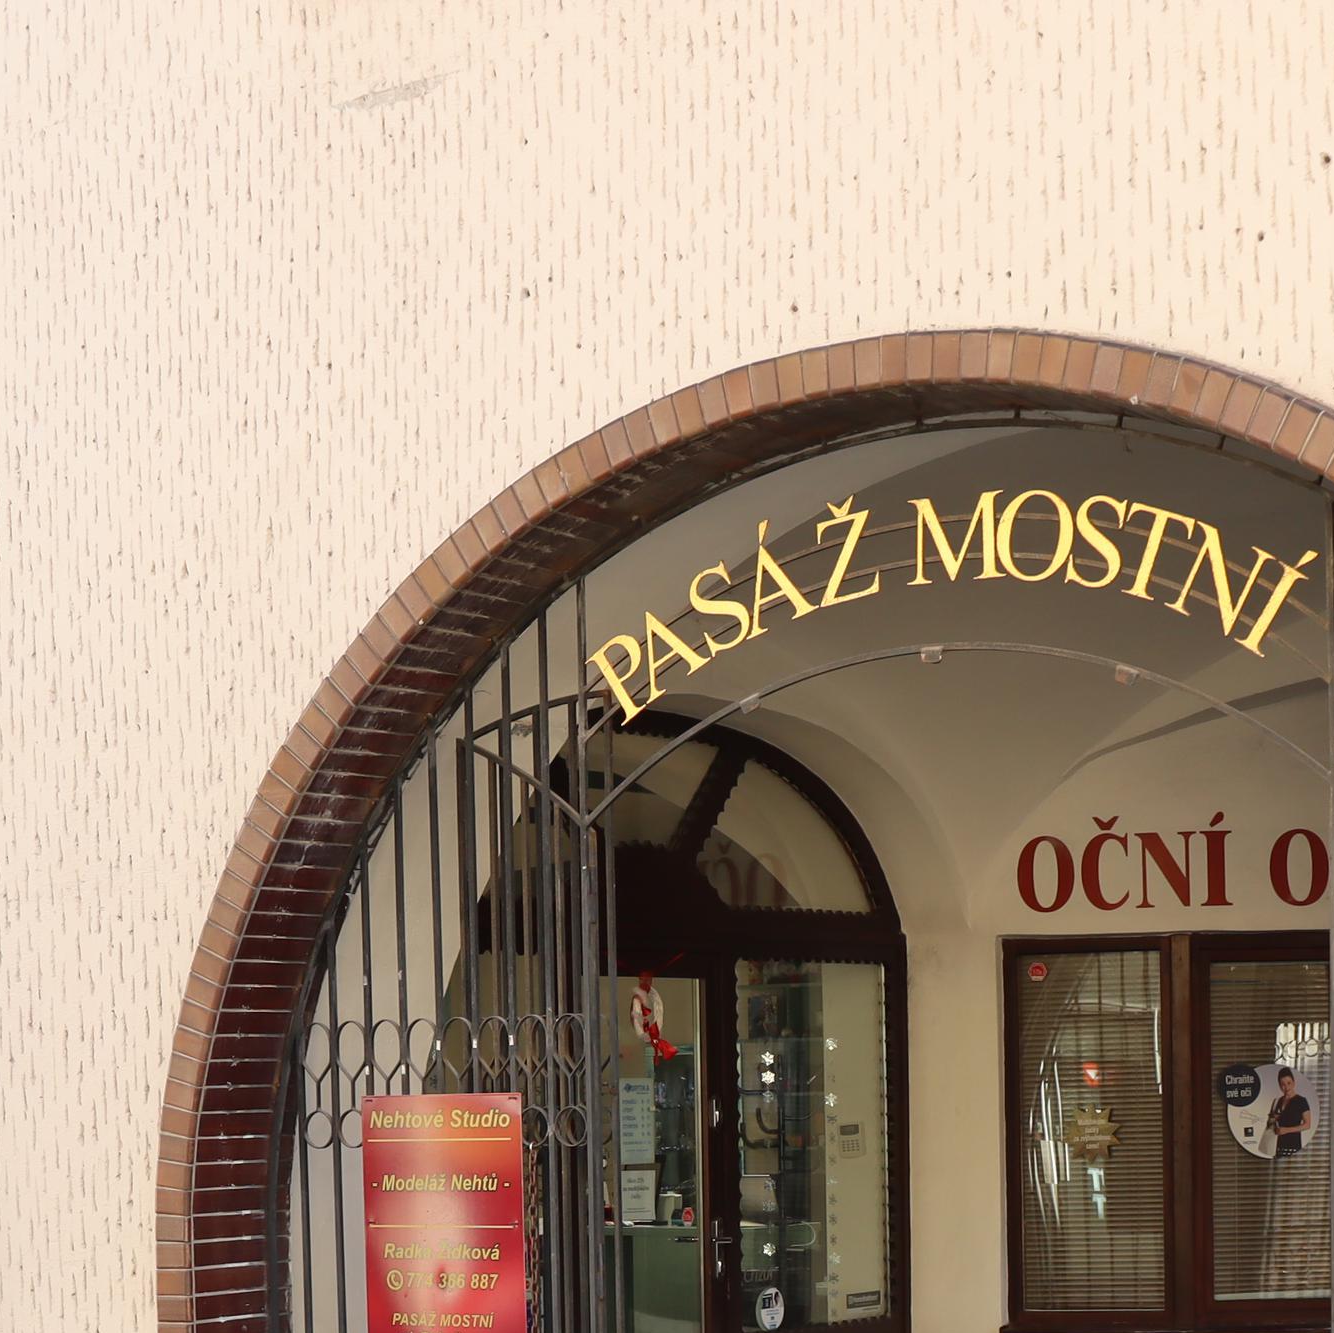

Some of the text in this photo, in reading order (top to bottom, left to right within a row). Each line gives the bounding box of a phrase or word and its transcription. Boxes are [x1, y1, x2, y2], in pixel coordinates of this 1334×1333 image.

[585, 489, 1319, 726] PASÁŽ MOSTNÍ
[1016, 811, 1234, 913] OČNÍ
[1225, 1074, 1255, 1085] Chraňte
[1226, 1087, 1252, 1098] své oči
[369, 1109, 511, 1129] Nehtové Studio
[382, 1174, 446, 1192] Modeláž
[450, 1172, 498, 1191] Nehtů
[384, 1243, 432, 1259] Radka
[470, 1273, 498, 1289] 887
[392, 1311, 495, 1329] PASÁŽ MOSTNÍ
